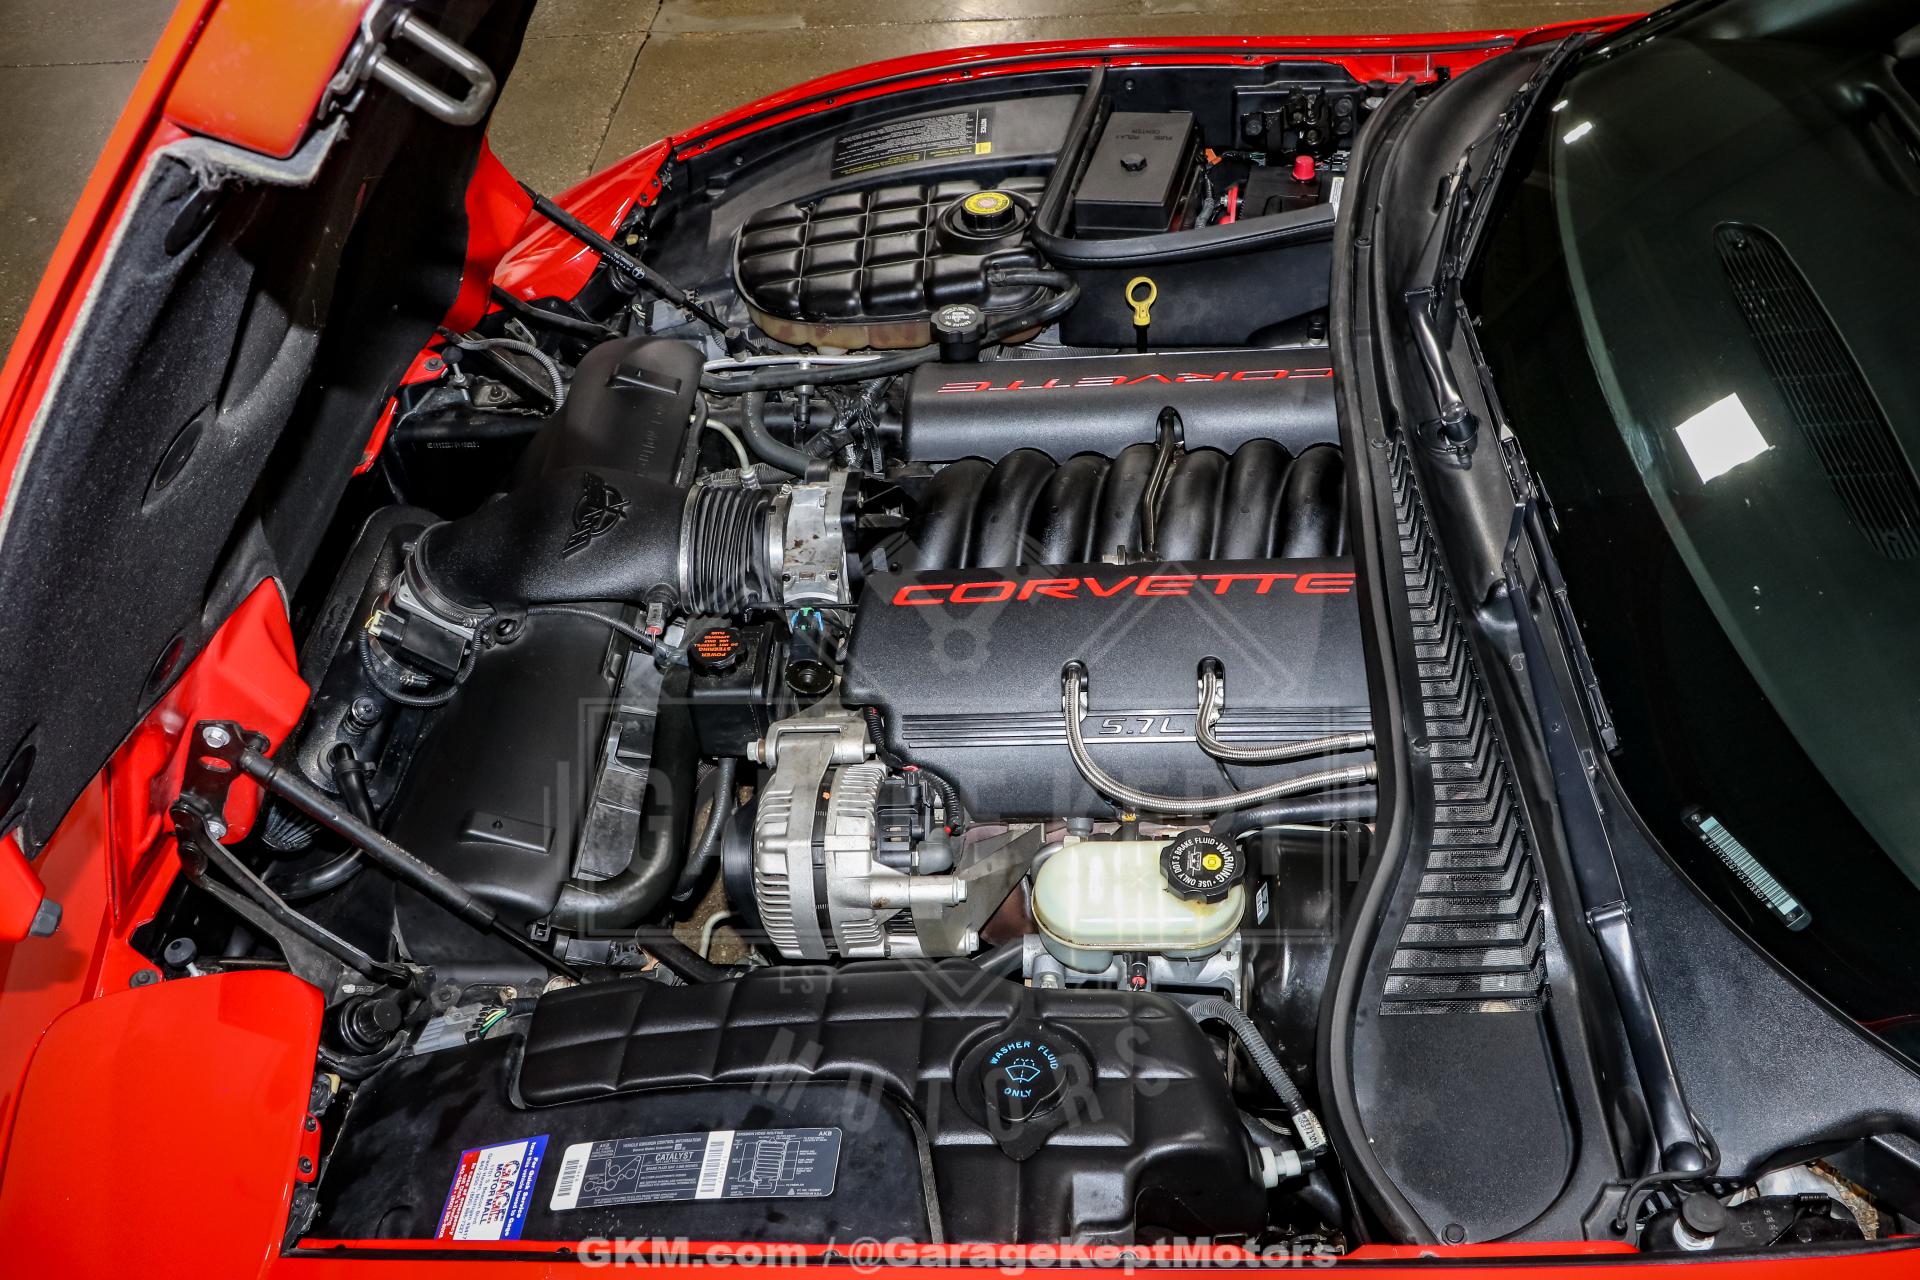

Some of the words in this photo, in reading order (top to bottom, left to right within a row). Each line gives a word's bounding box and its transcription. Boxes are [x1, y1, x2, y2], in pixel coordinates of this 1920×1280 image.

[937, 367, 1334, 393] CORVETTE
[891, 572, 1357, 606] CORVETTE
[1099, 717, 1185, 735] 5.7L
[1174, 839, 1194, 855] BRAKE
[1171, 861, 1182, 873] DOT
[1216, 842, 1234, 882] WARNING
[1178, 872, 1196, 885] ONLY
[1197, 879, 1212, 887] USE
[990, 1041, 1031, 1064] WASHER
[1037, 1045, 1059, 1070] FLUID
[1004, 1087, 1032, 1097] ONLY
[530, 1157, 539, 1168] For
[656, 1152, 694, 1161] CATALYST
[488, 1163, 504, 1197] MOTOR
[524, 1170, 534, 1190] Quick
[487, 1160, 520, 1224] GAGE
[479, 1198, 493, 1226] MALL
[516, 1191, 528, 1219] Service
